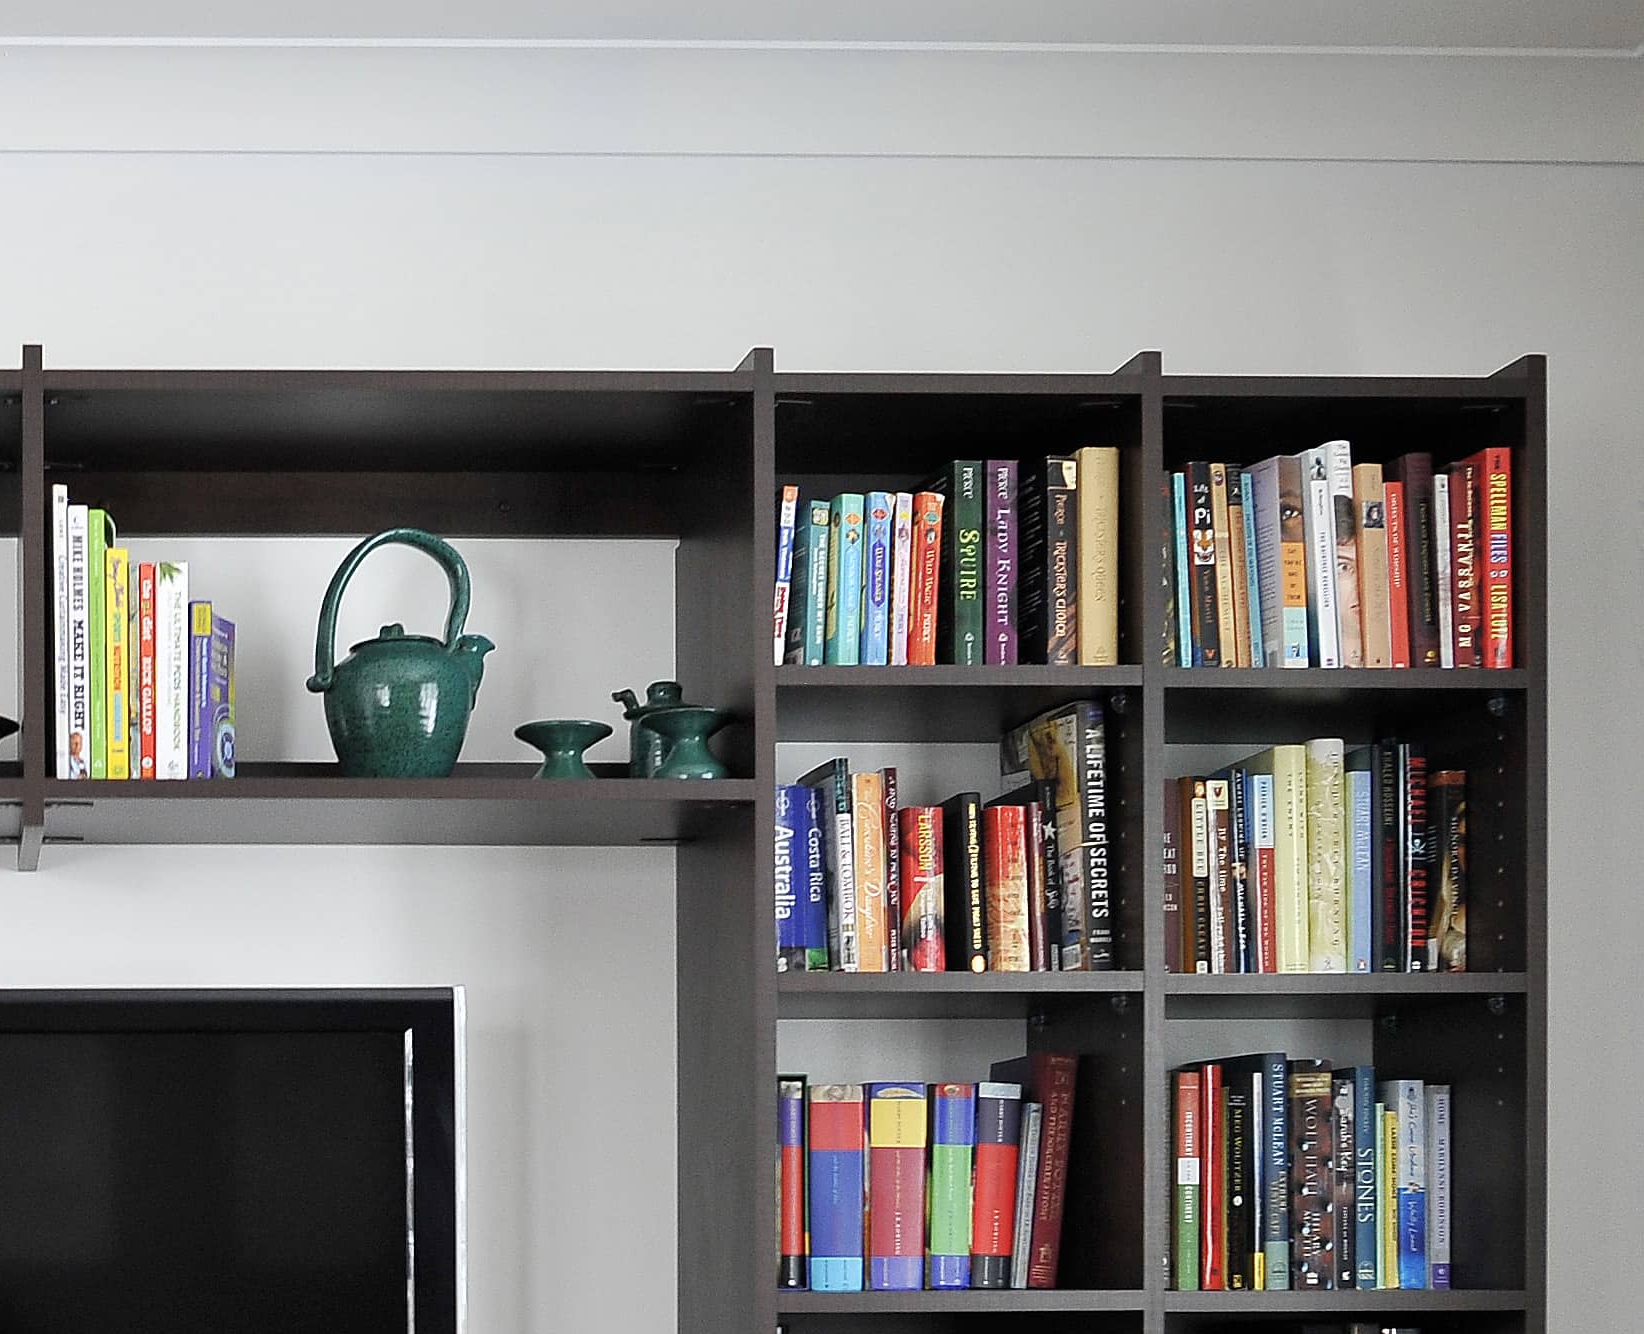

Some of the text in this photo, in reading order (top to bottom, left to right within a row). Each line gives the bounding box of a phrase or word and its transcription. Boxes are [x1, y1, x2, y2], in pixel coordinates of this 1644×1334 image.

[1195, 507, 1211, 526] Pi
[1490, 473, 1508, 640] SPELLMAN FILES LISA LUTZ
[142, 617, 152, 640] diet
[174, 592, 182, 609] THE
[72, 536, 84, 730] MIKE HOLMES MAKE IT RIGHT
[173, 612, 181, 661] ULTIMATE
[142, 688, 151, 735] GALLOP
[172, 693, 180, 752] HANDBOOK
[839, 818, 849, 846] BALI
[918, 814, 933, 871] LARSSON
[1085, 728, 1109, 919] A LIFETIME OF SECRETS
[1195, 804, 1204, 845] LITTLE
[1407, 757, 1428, 947] MICHAEL CRICHTON
[774, 825, 795, 919] Australia
[807, 828, 823, 902] Costa Rica
[841, 862, 853, 920] LOMBOK
[1271, 1064, 1284, 1166] STUART McLEAN
[1437, 1098, 1445, 1125] HOME
[1336, 1152, 1353, 1171] Key
[1357, 1148, 1374, 1223] STONES
